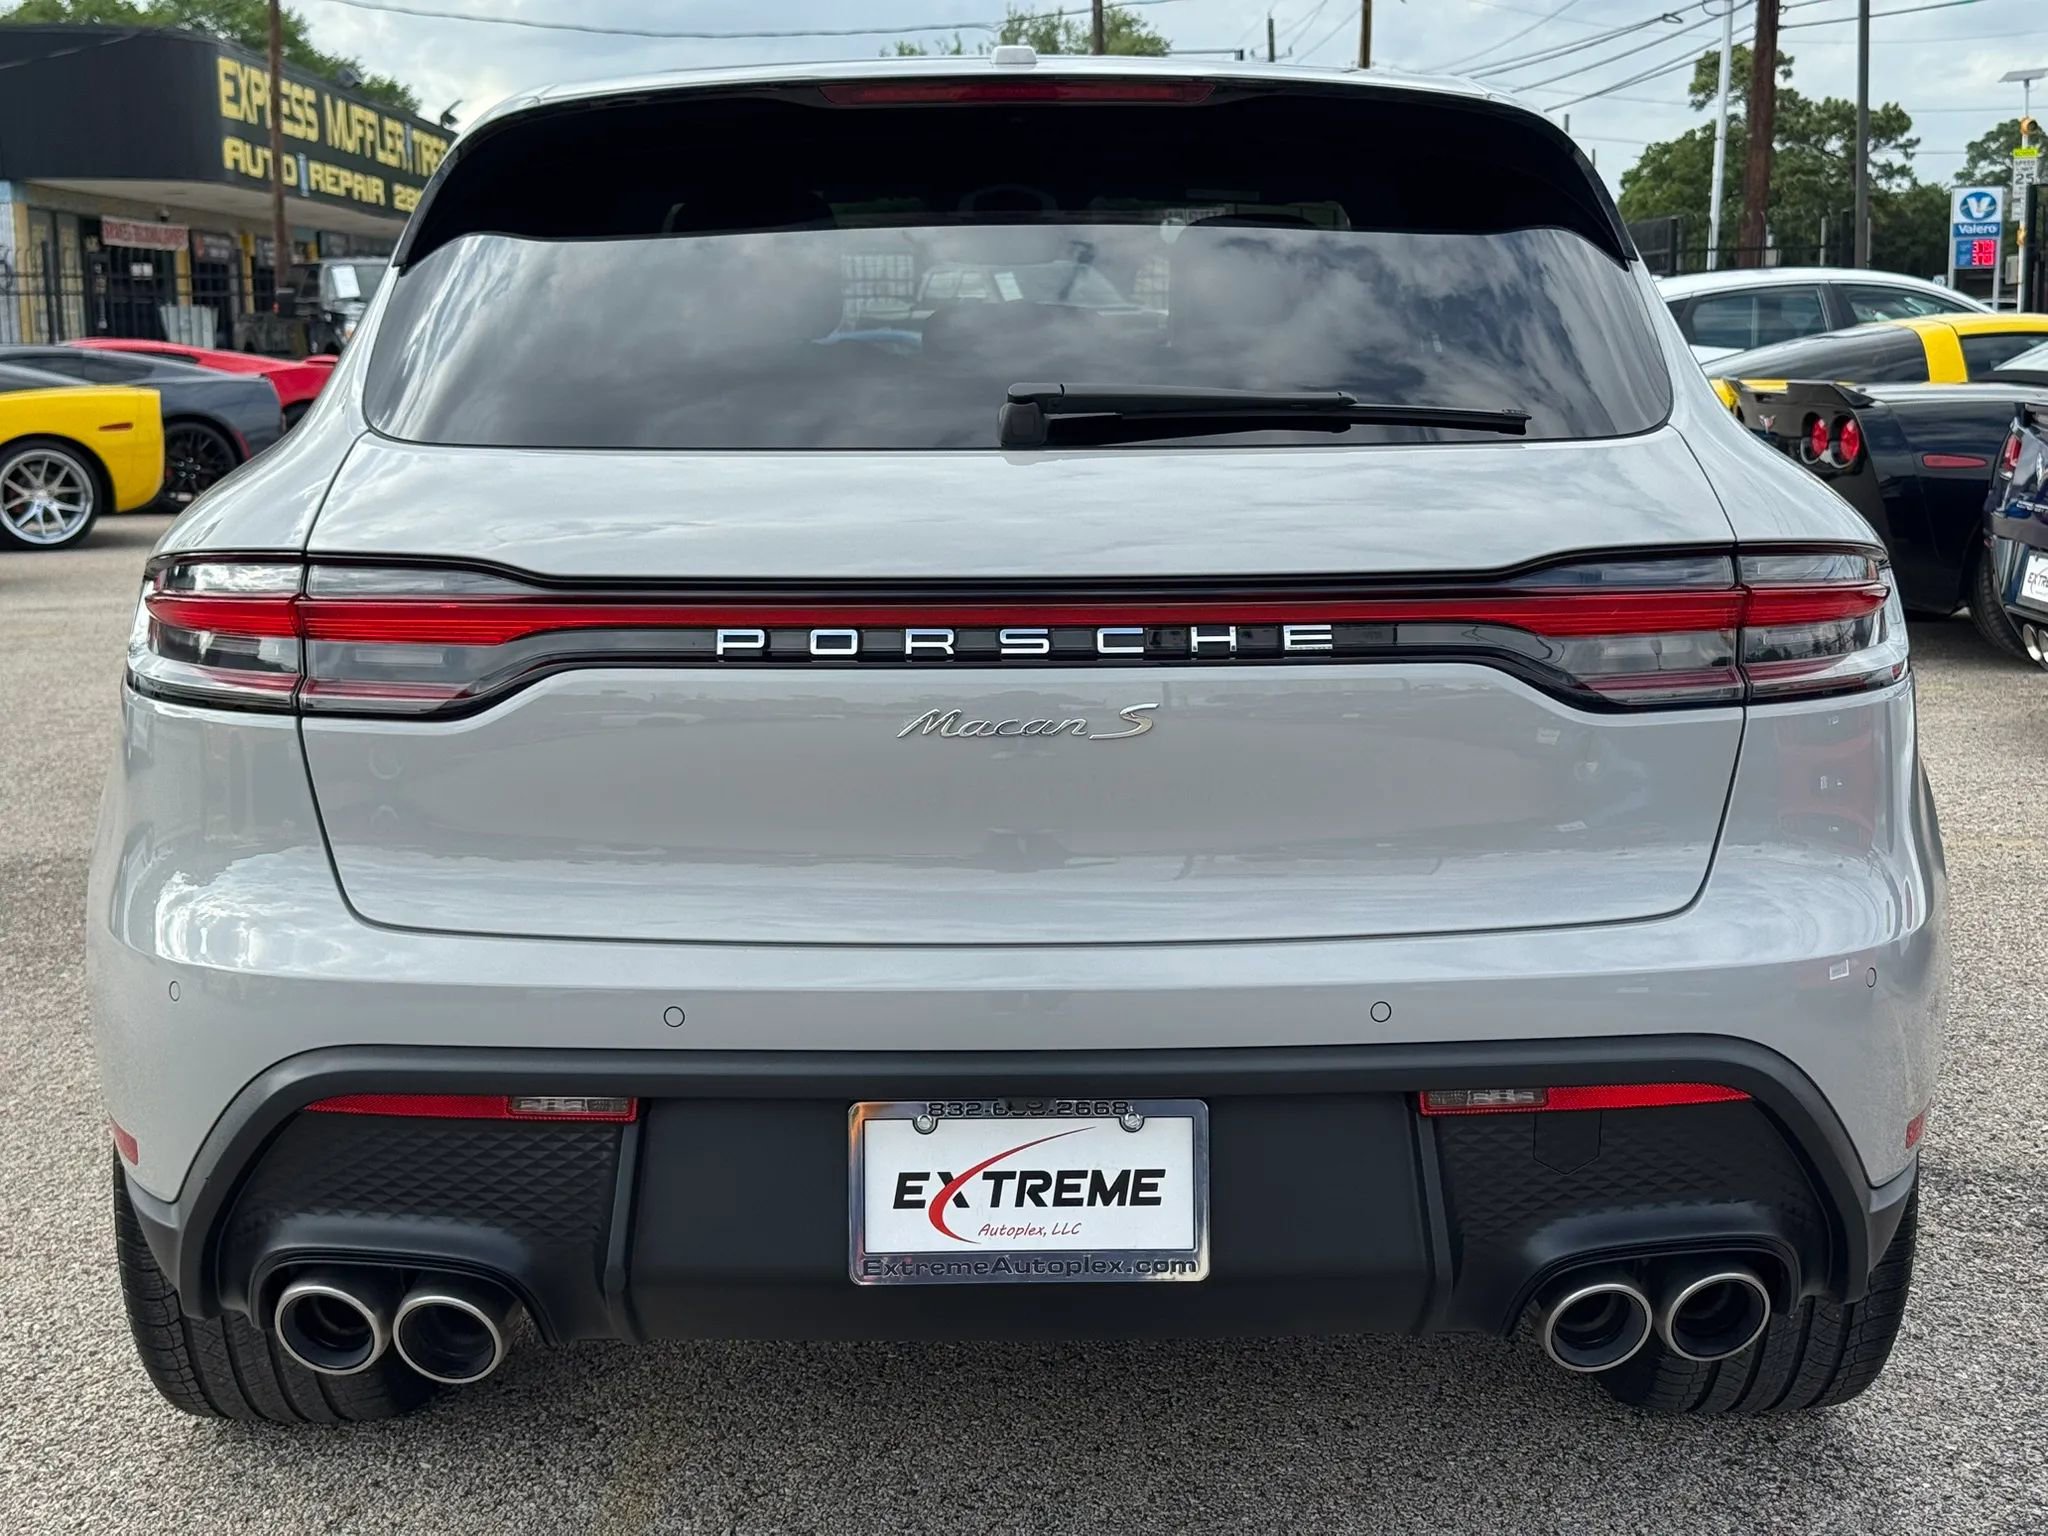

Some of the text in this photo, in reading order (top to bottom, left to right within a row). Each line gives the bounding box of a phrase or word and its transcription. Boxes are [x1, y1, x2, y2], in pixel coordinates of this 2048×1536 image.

[323, 93, 407, 171] MUFFLER
[222, 136, 423, 213] AUTO REPAIR 28
[2015, 173, 2034, 185] 25
[1958, 224, 1997, 234] Valero
[717, 624, 1333, 656] PORSCHE
[896, 702, 1160, 741] Macan S
[928, 1101, 1131, 1118] 832-6-2668
[893, 1169, 1166, 1209] EXTREME
[978, 1222, 1083, 1240] Autoplex, LLC
[862, 1255, 1198, 1279] ExtremeAutoplex.com
